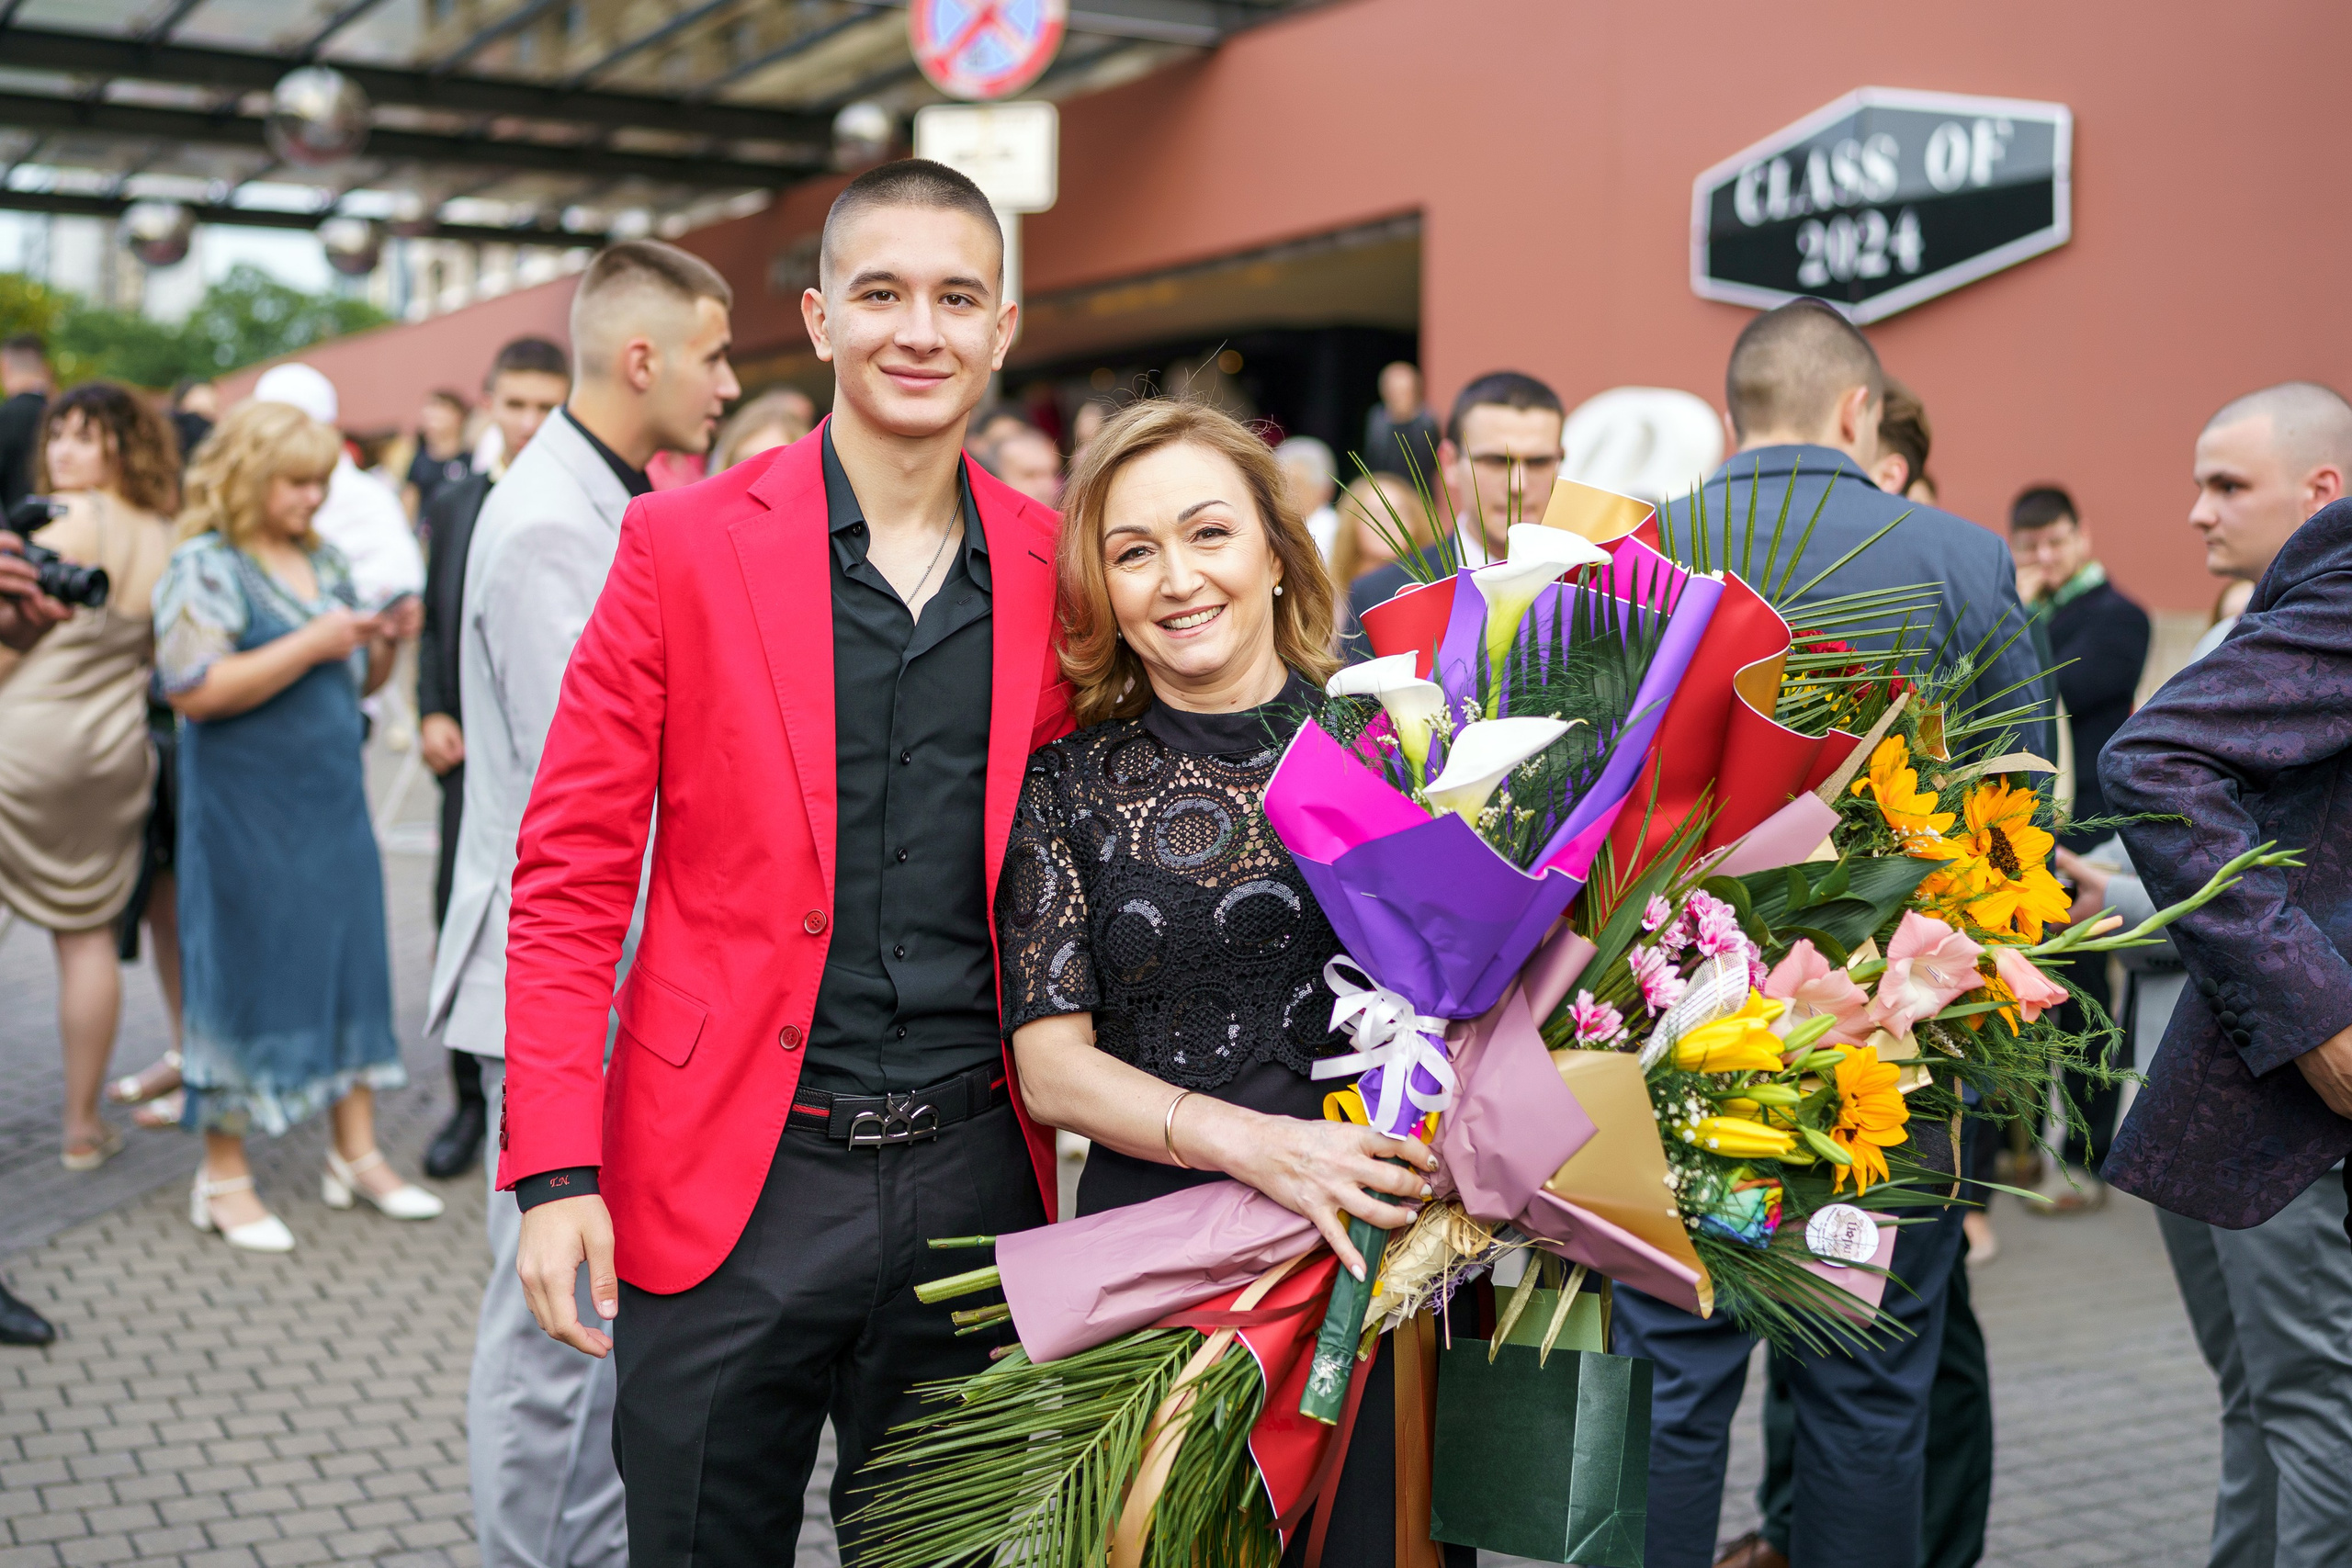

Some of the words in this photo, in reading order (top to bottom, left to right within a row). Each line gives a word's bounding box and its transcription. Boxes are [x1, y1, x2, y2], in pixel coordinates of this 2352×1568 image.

[1734, 131, 1900, 227] CLASS
[1924, 118, 2014, 193] OF
[1795, 206, 1924, 288] 2024
